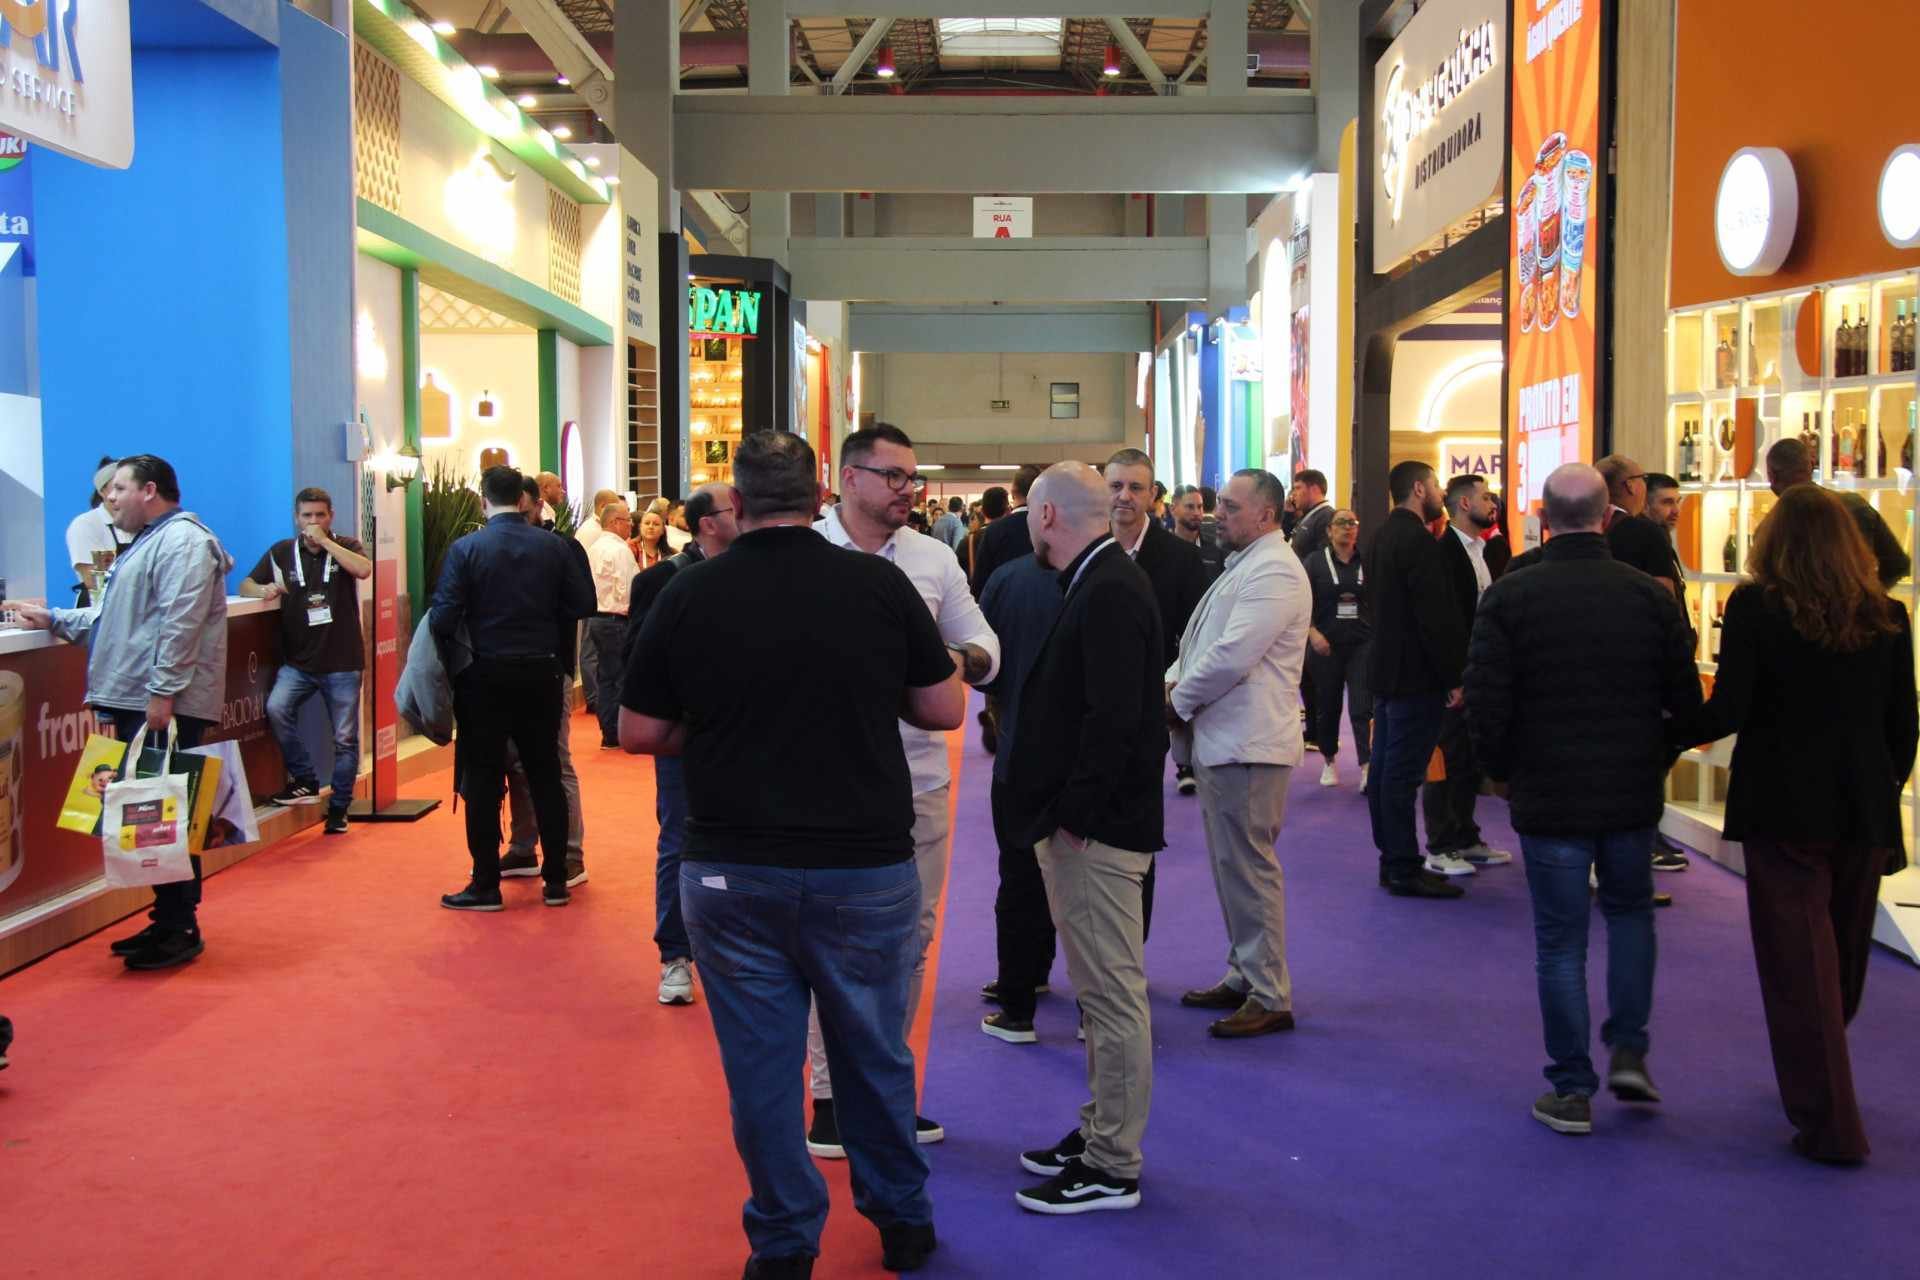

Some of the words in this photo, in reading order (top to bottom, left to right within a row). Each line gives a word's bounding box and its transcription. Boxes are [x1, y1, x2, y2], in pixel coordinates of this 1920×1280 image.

[12, 66, 77, 119] SERVICE
[1414, 112, 1482, 190] DISTRIBUIDORA
[993, 214, 1012, 222] RUA
